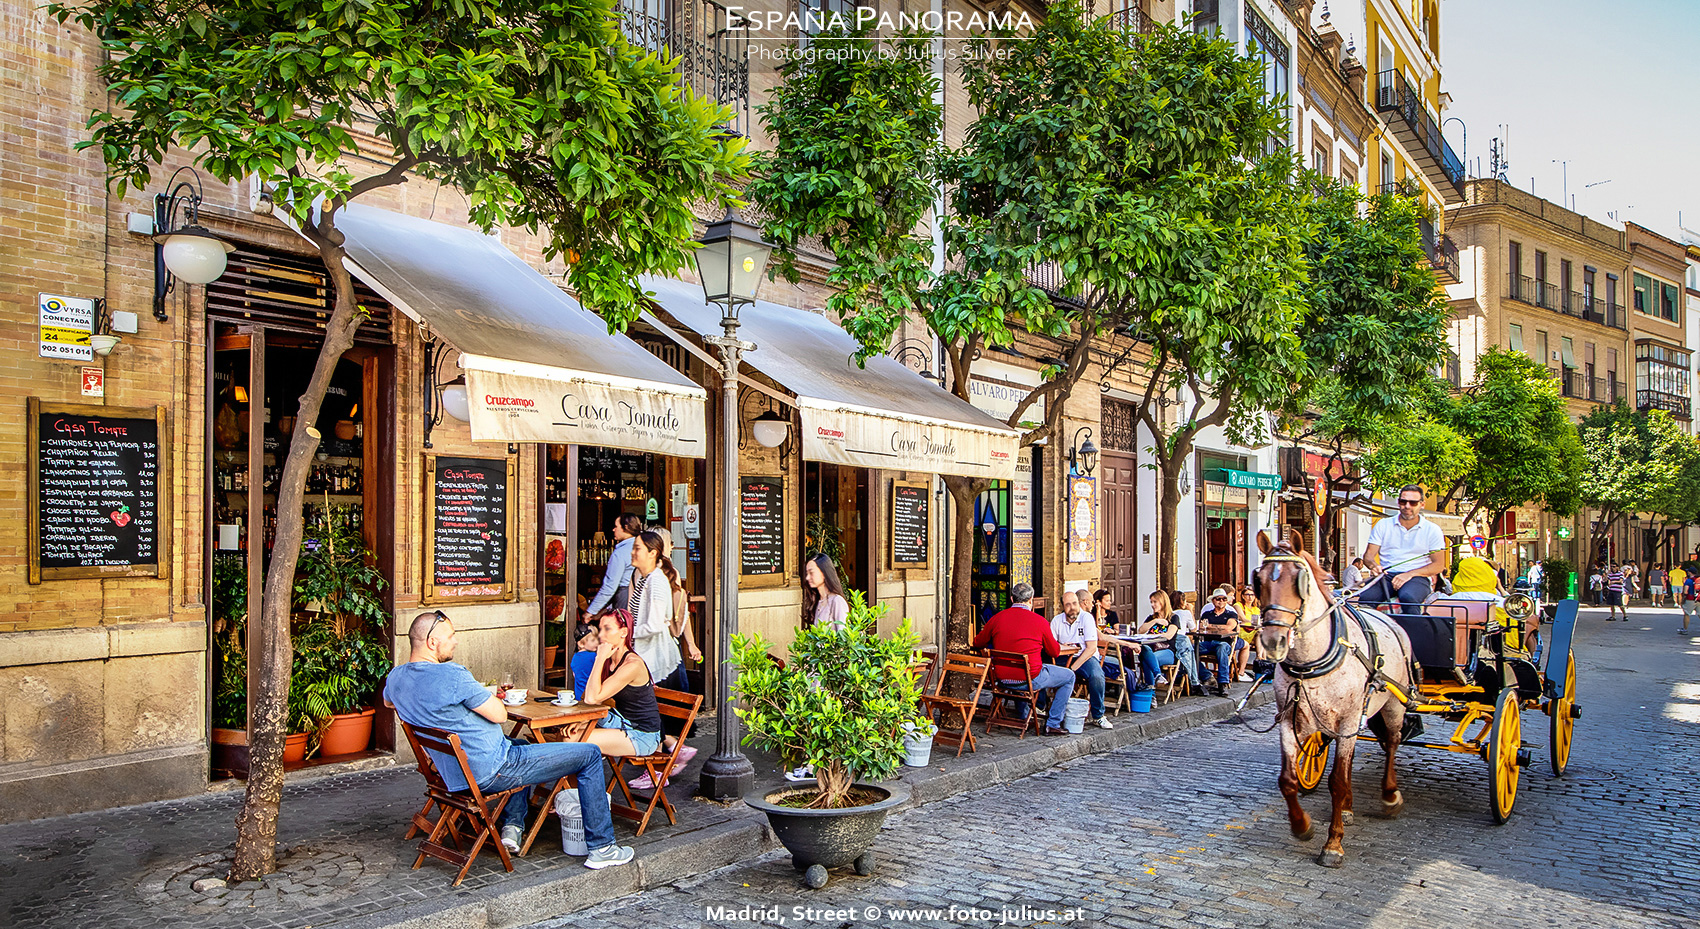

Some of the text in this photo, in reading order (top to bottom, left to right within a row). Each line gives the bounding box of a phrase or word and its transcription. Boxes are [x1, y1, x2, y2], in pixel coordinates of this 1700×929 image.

[63, 307, 92, 315] VYRSA
[43, 315, 90, 324] CONECTADA
[970, 382, 1008, 401] ALVARO
[485, 394, 534, 408] Cruzcampo
[561, 394, 680, 432] Casa Tomate
[817, 426, 844, 438] Cruzcampo
[47, 439, 93, 447] CHIPIRONES
[890, 430, 916, 452] Casa
[923, 434, 956, 458] Tomate
[46, 449, 89, 458] CHAMPIÑON
[990, 450, 1009, 458] Cruzcampo
[44, 457, 75, 468] TARTAR
[45, 479, 90, 488] ENSALADILLA
[101, 480, 109, 488] LA
[1238, 475, 1273, 487] ALVARO PEREGIL
[46, 489, 87, 498] ESPINACAS
[46, 499, 86, 508] CROQUETAS
[45, 524, 77, 534] PATATAS
[46, 534, 86, 542] CARRILLADA
